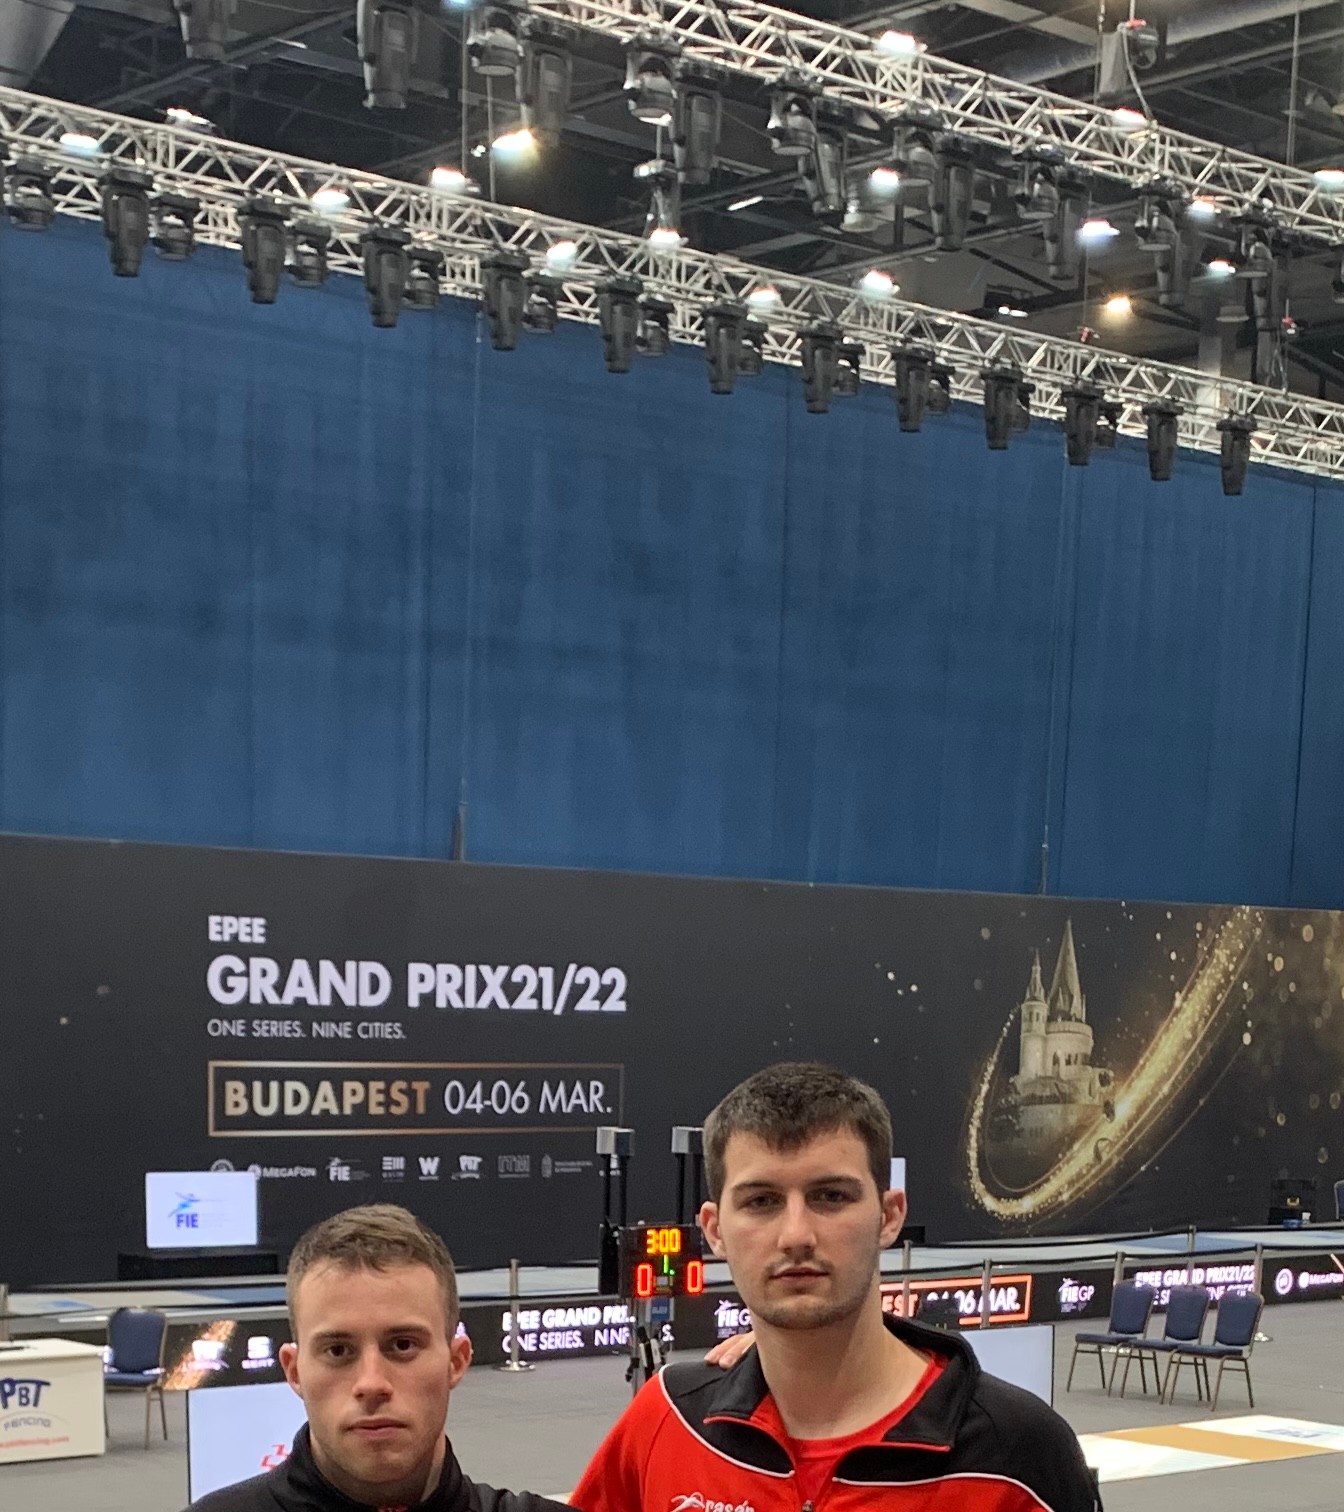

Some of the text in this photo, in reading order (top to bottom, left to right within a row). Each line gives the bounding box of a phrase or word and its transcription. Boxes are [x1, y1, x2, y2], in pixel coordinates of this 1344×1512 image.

[208, 915, 267, 943] EPEE
[207, 954, 627, 1016] GRAND PRIX21/22
[207, 1018, 406, 1039] ONE SERIES. NINE CITIES.
[224, 1079, 613, 1116] BUDAPEST 04-06 MAR.
[329, 1166, 351, 1181] FIE
[176, 1213, 199, 1229] FIE
[646, 1228, 682, 1254] 3:00
[636, 1263, 653, 1297] 0
[686, 1260, 703, 1294] 0
[542, 1307, 601, 1328] GRAND
[539, 1330, 585, 1350] SERIES.
